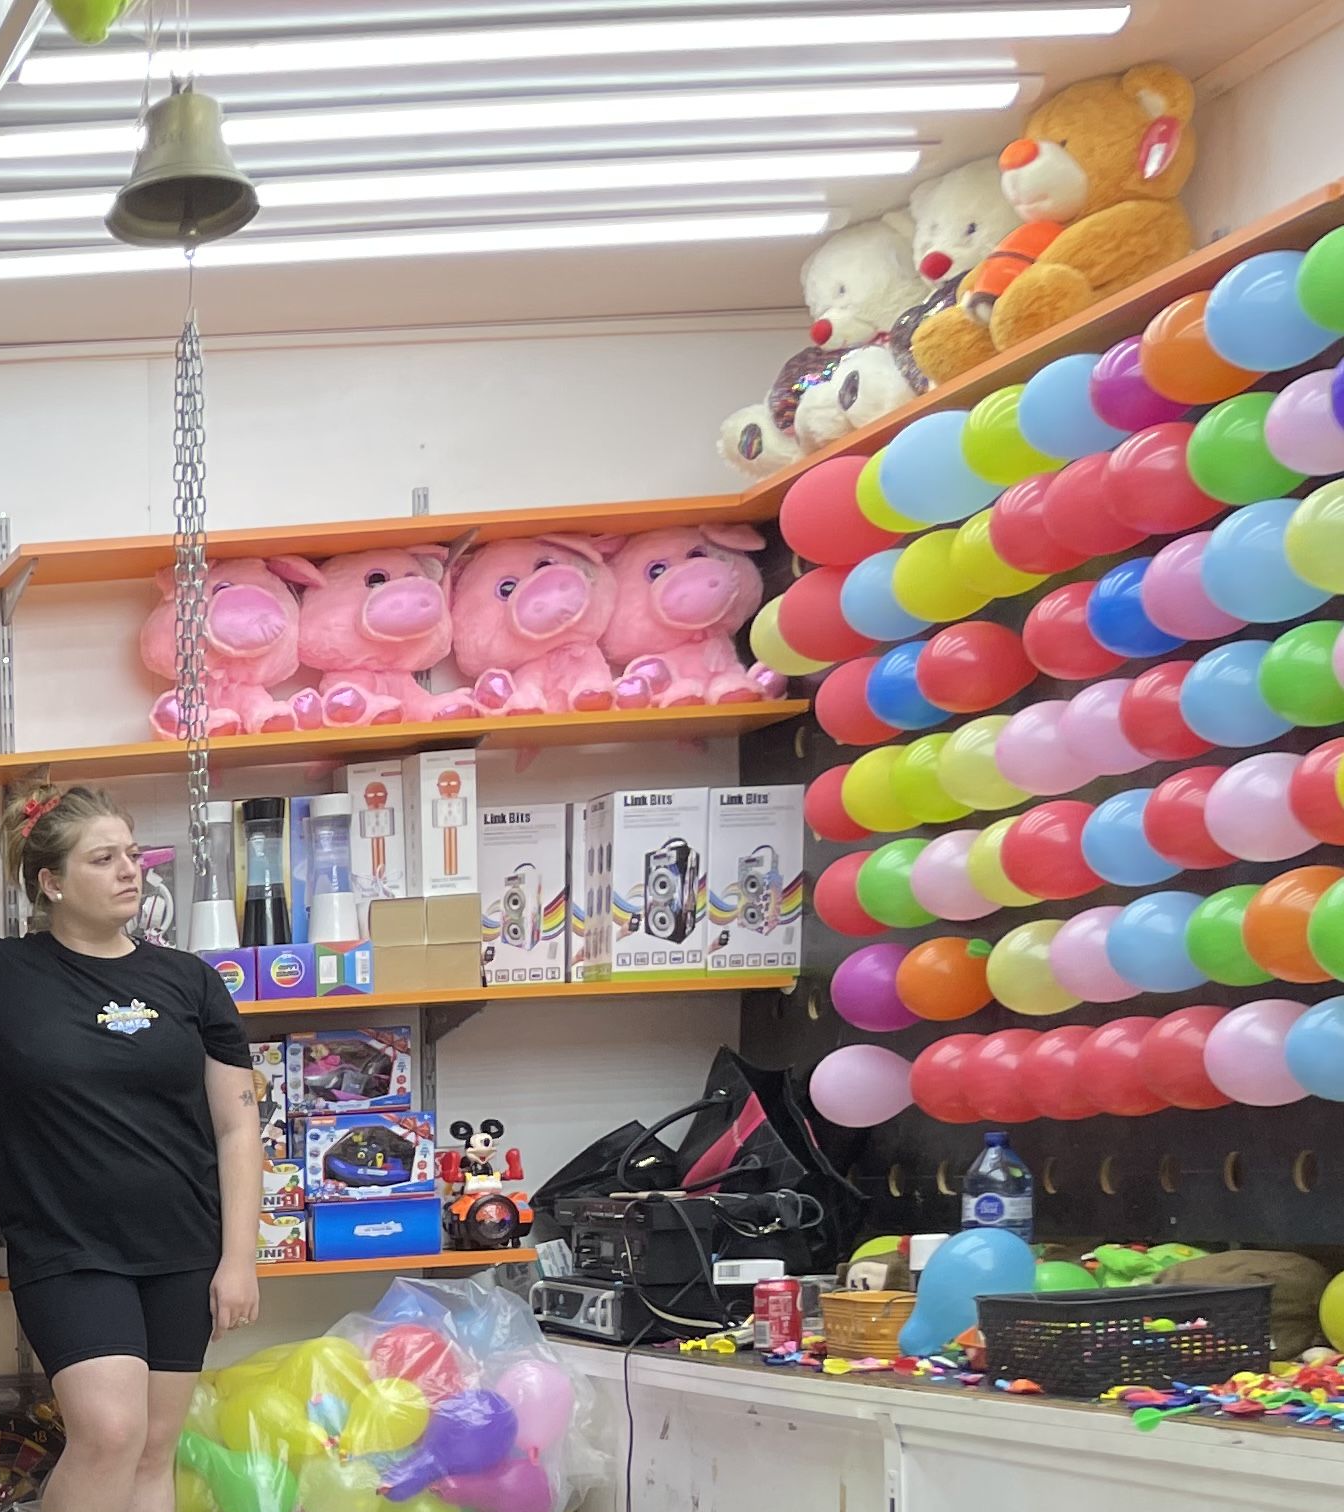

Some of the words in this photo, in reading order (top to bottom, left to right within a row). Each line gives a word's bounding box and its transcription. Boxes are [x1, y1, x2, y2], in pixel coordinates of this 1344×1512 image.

[624, 794, 647, 807] Link
[649, 793, 673, 806] Bits
[719, 794, 744, 806] Link
[745, 792, 769, 805] Bits
[483, 812, 507, 825] Link
[508, 811, 531, 824] Bits
[8, 1420, 15, 1433] 1
[32, 1429, 49, 1442] 18
